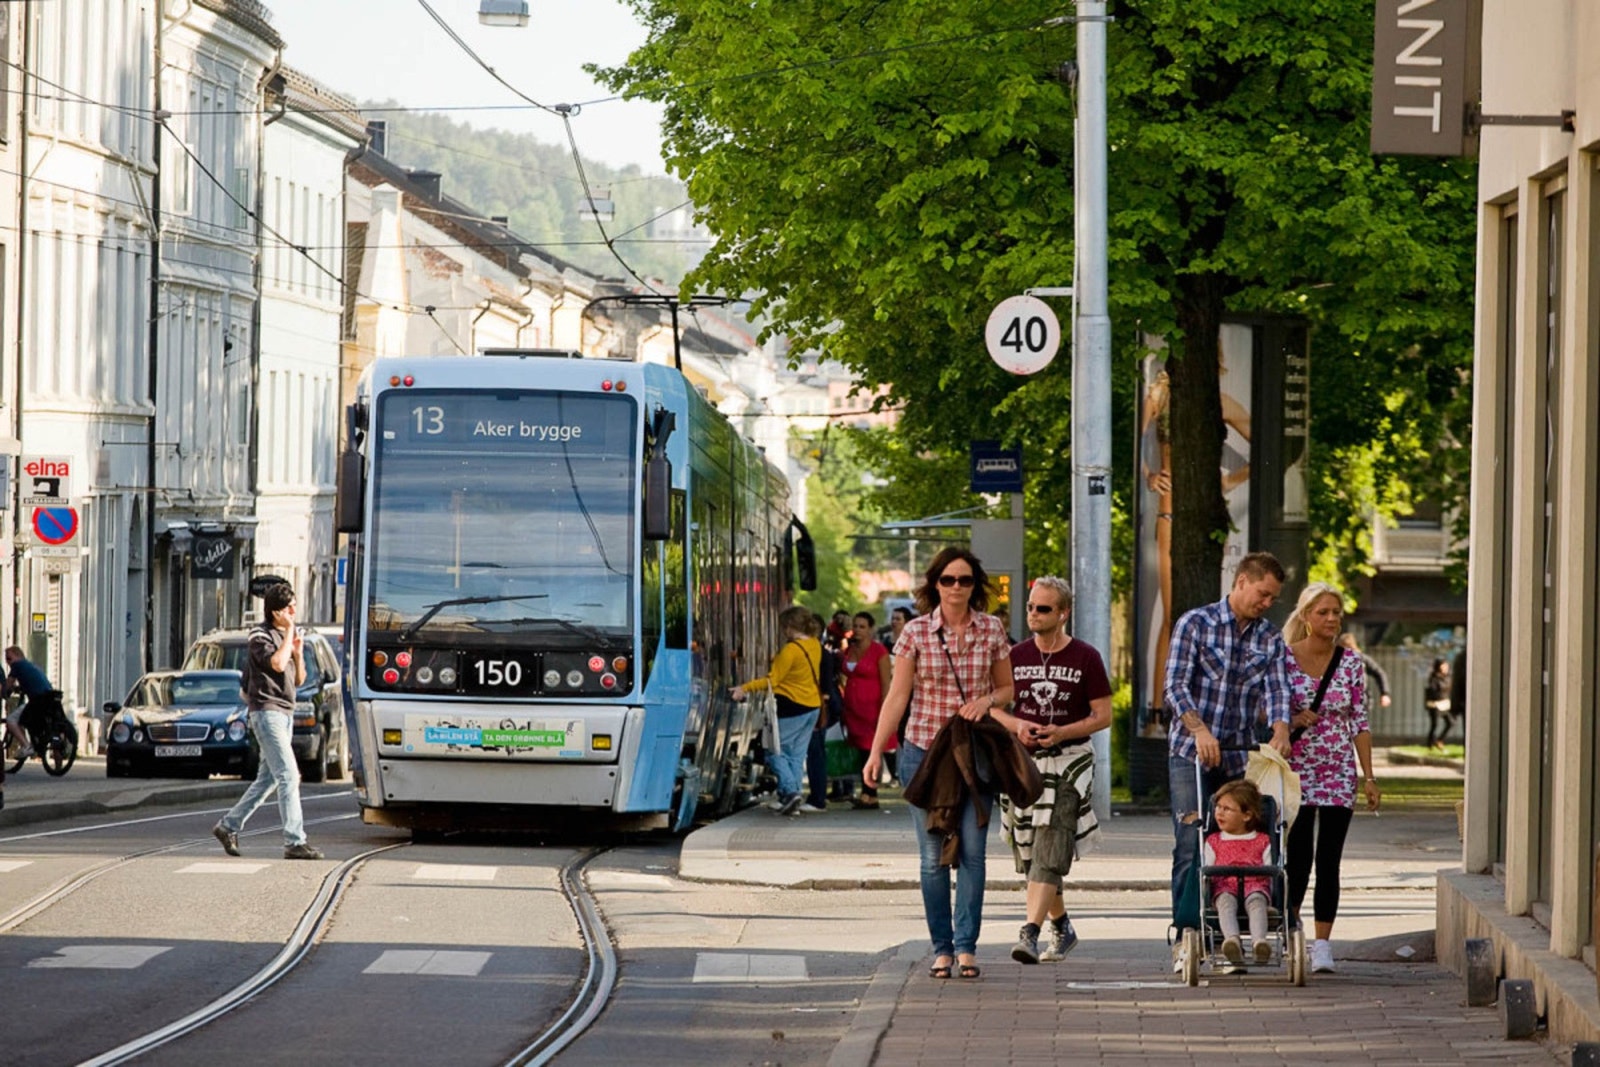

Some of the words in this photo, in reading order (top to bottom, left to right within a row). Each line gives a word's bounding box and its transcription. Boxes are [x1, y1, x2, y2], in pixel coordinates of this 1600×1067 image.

[1000, 316, 1047, 353] 40
[412, 406, 445, 435] 13
[473, 420, 513, 437] Aker
[519, 420, 582, 442] brygge
[24, 457, 69, 476] elna
[473, 660, 521, 686] 150
[484, 733, 494, 741] TA
[495, 733, 512, 742] DEN
[547, 733, 563, 743] BLÅ
